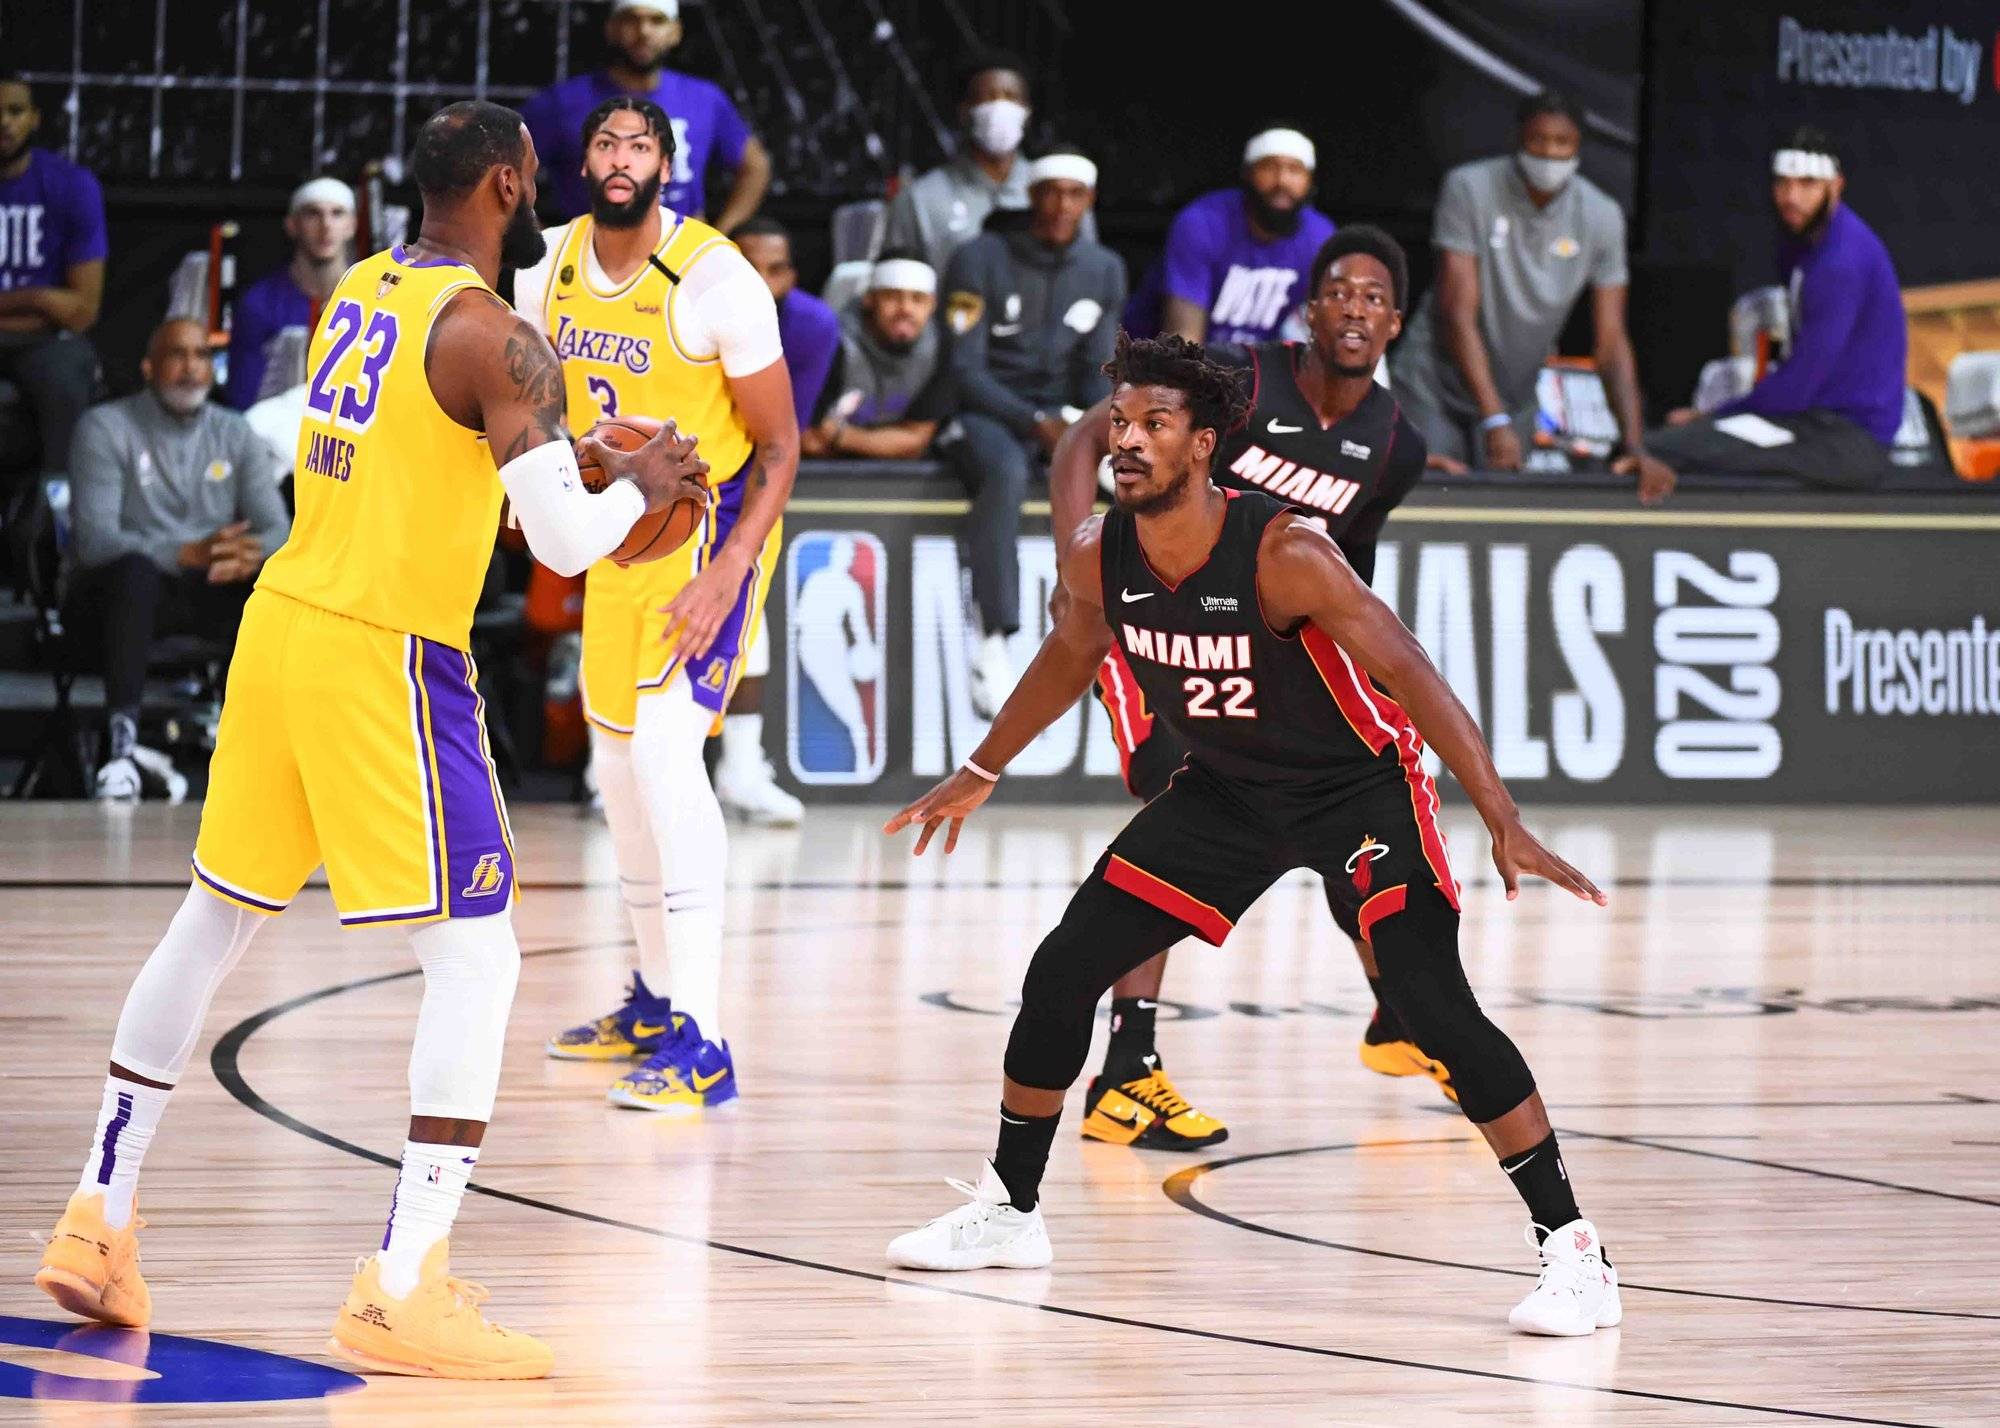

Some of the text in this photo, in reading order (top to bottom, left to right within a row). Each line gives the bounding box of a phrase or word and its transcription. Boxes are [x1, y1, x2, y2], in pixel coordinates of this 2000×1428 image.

[1777, 15, 1982, 104] Presented by
[305, 298, 399, 434] 23
[557, 315, 651, 374] LAKERS
[305, 431, 355, 483] JAMES
[1229, 444, 1362, 516] MIAMI
[1200, 595, 1239, 606] Ultimate
[1122, 623, 1251, 671] MIAMI
[1653, 550, 1782, 779] 2020
[1183, 675, 1258, 719] 22
